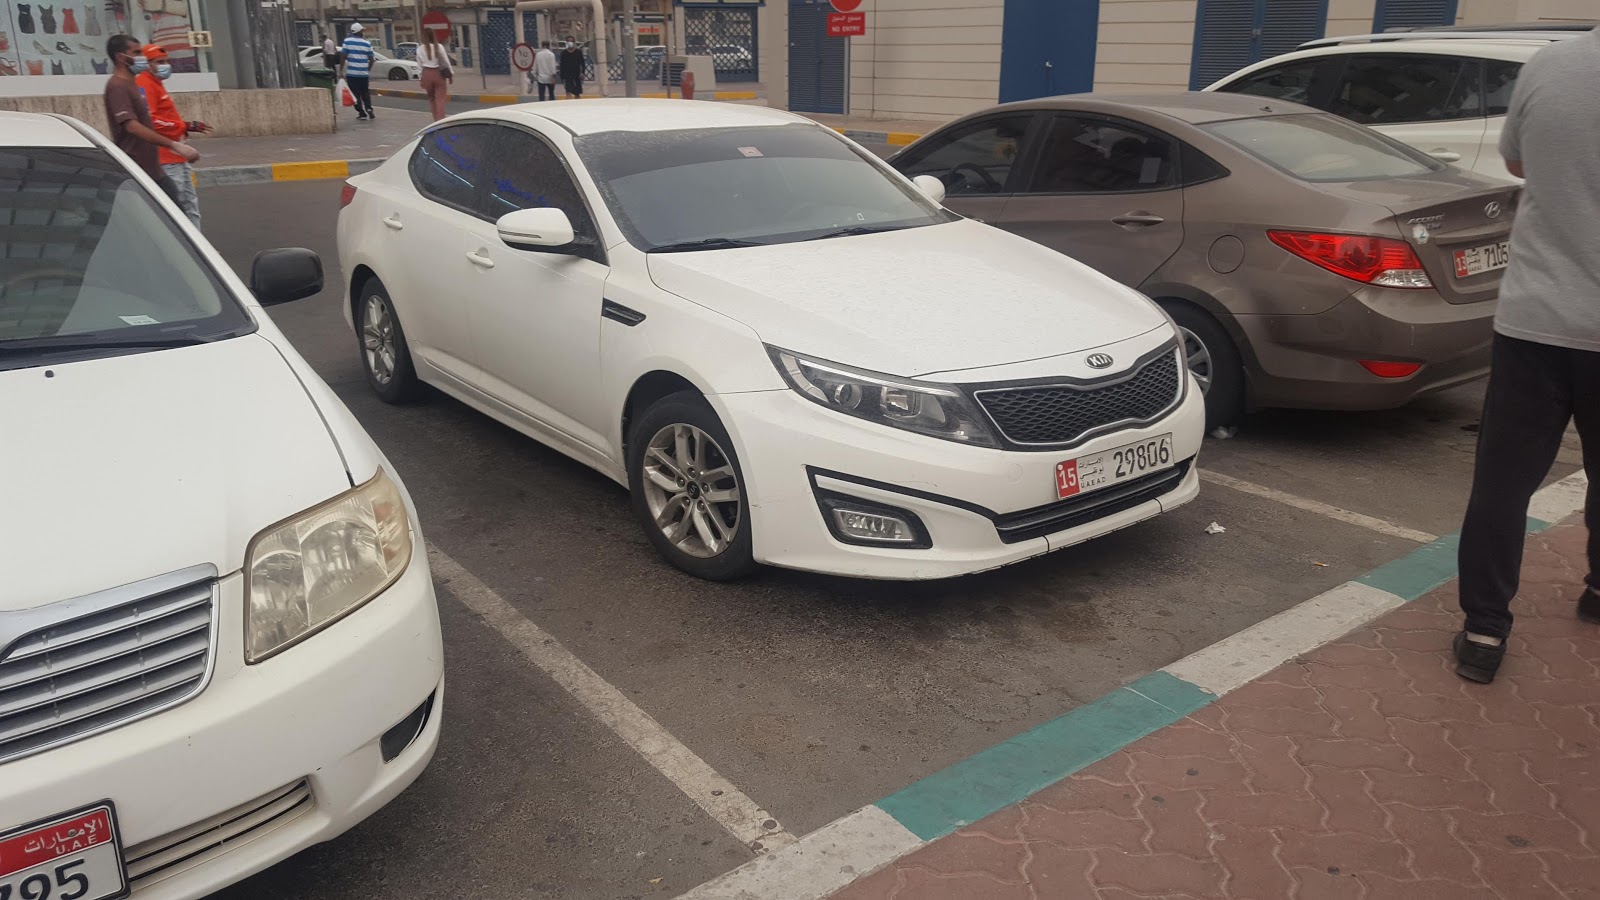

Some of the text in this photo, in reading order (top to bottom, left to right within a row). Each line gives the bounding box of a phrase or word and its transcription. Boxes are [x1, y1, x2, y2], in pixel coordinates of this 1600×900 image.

[1484, 243, 1510, 268] 7105
[1088, 354, 1112, 366] KIA
[1113, 438, 1169, 478] 29806
[1059, 467, 1077, 489] 15
[0, 858, 89, 900] 95
